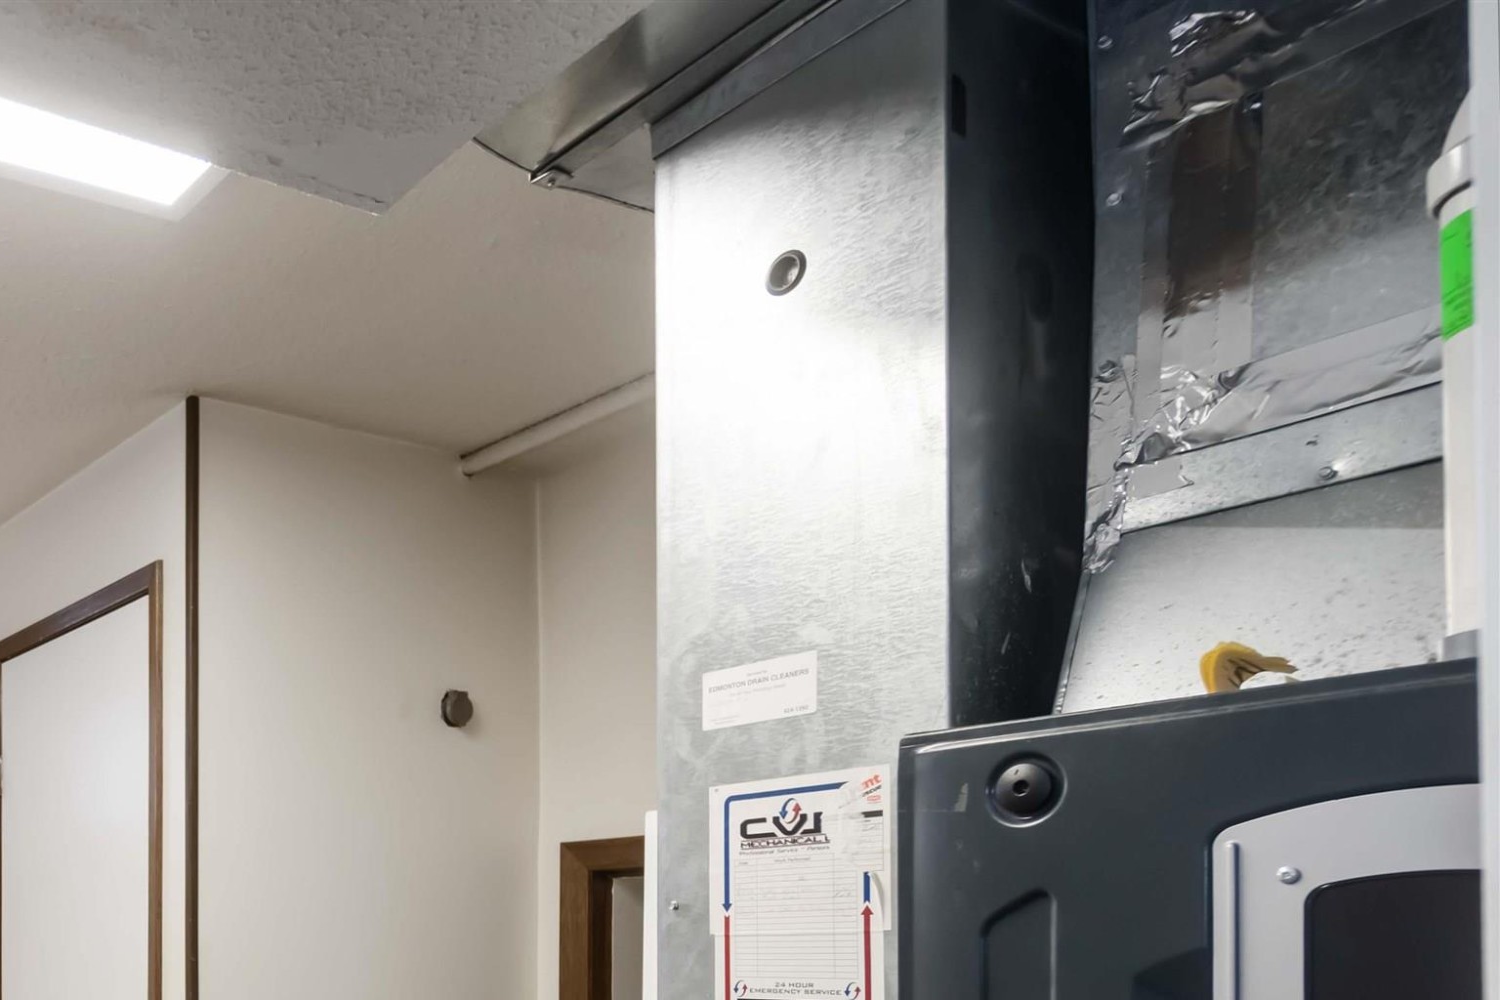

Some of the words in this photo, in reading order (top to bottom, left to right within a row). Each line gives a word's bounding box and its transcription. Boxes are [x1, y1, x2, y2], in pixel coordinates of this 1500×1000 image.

[708, 681, 747, 694] EDMONTON
[747, 676, 770, 687] DRAIN
[770, 668, 810, 682] CLEANERS
[749, 987, 801, 995] EMERGENCY
